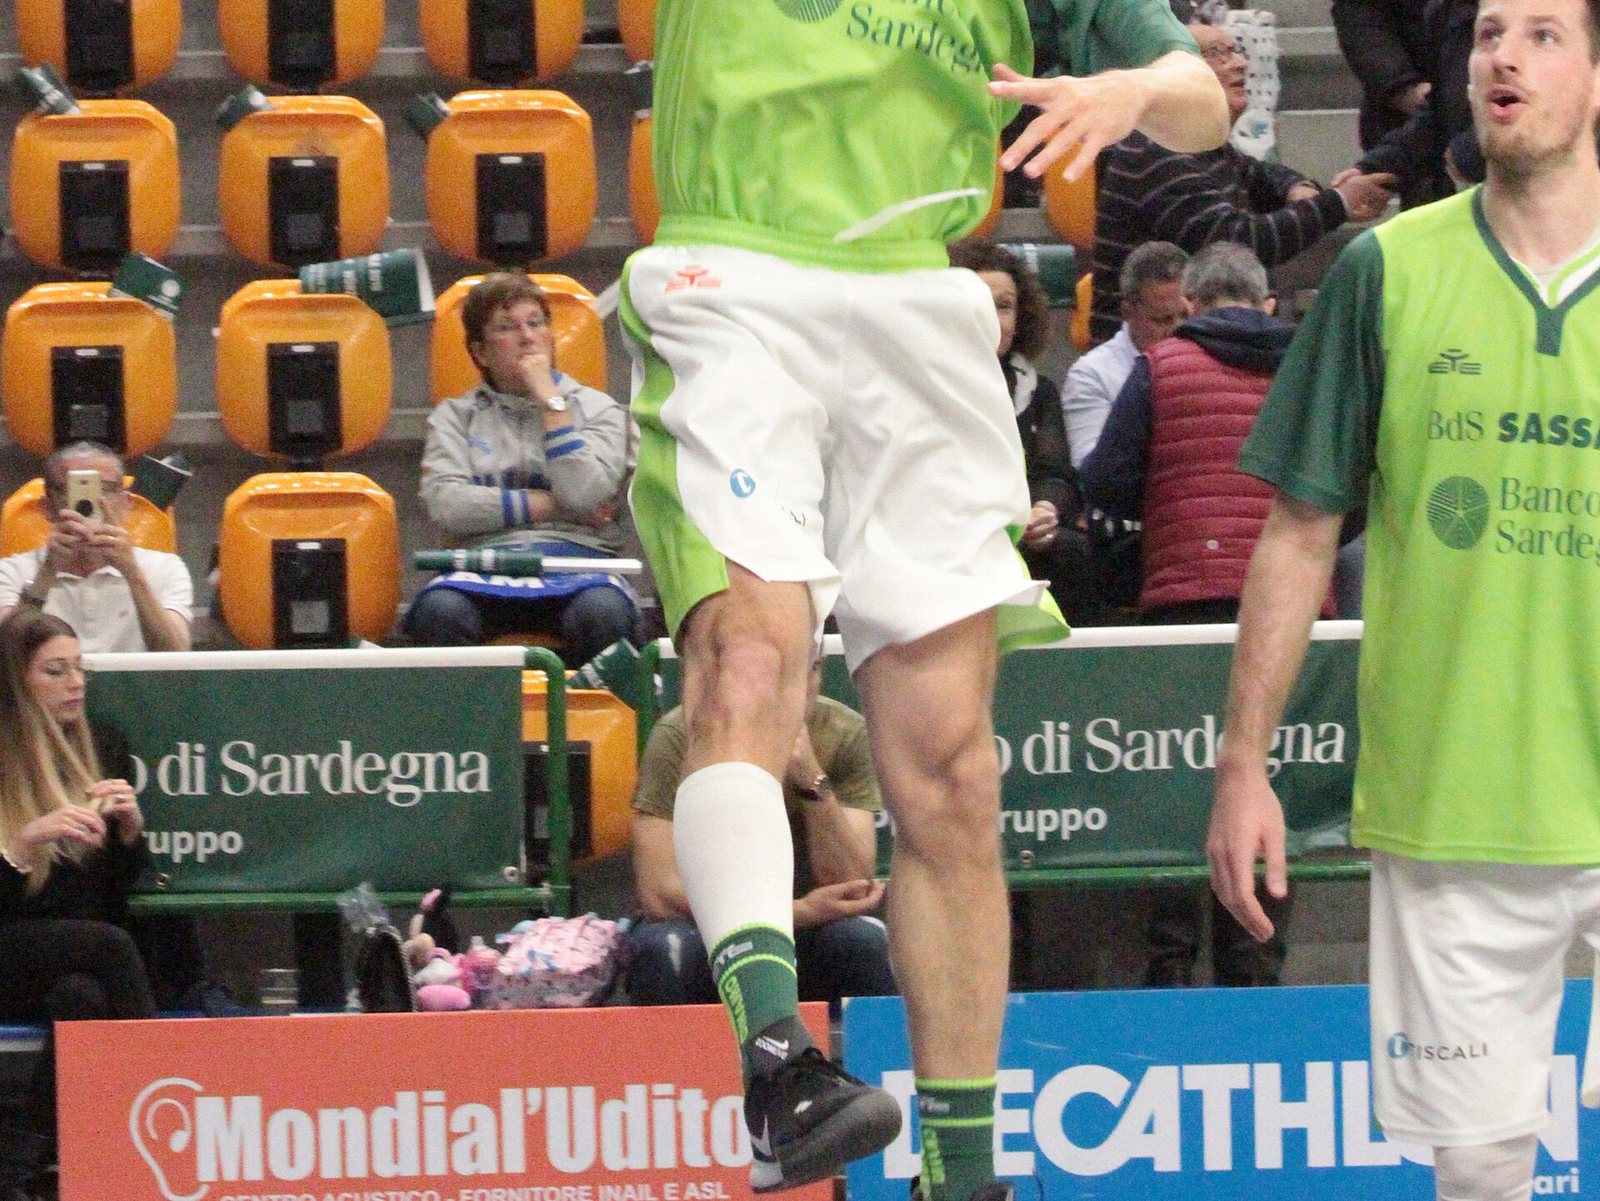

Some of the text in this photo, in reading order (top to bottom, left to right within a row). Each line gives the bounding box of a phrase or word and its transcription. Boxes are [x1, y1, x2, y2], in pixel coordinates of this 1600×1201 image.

[1427, 411, 1600, 449] BdS SASS
[1501, 476, 1600, 518] Banco
[1496, 519, 1600, 568] Sarde
[1023, 722, 1071, 775] di
[1085, 715, 1346, 778] Sardgna
[157, 742, 209, 796] di
[220, 739, 491, 808] Sardegna
[196, 1083, 753, 1182] Mondial'Udito
[459, 1185, 594, 1201] FORNITORE
[598, 1182, 658, 1201] INAIL
[664, 1181, 680, 1200] E
[684, 1179, 731, 1201] ASL
